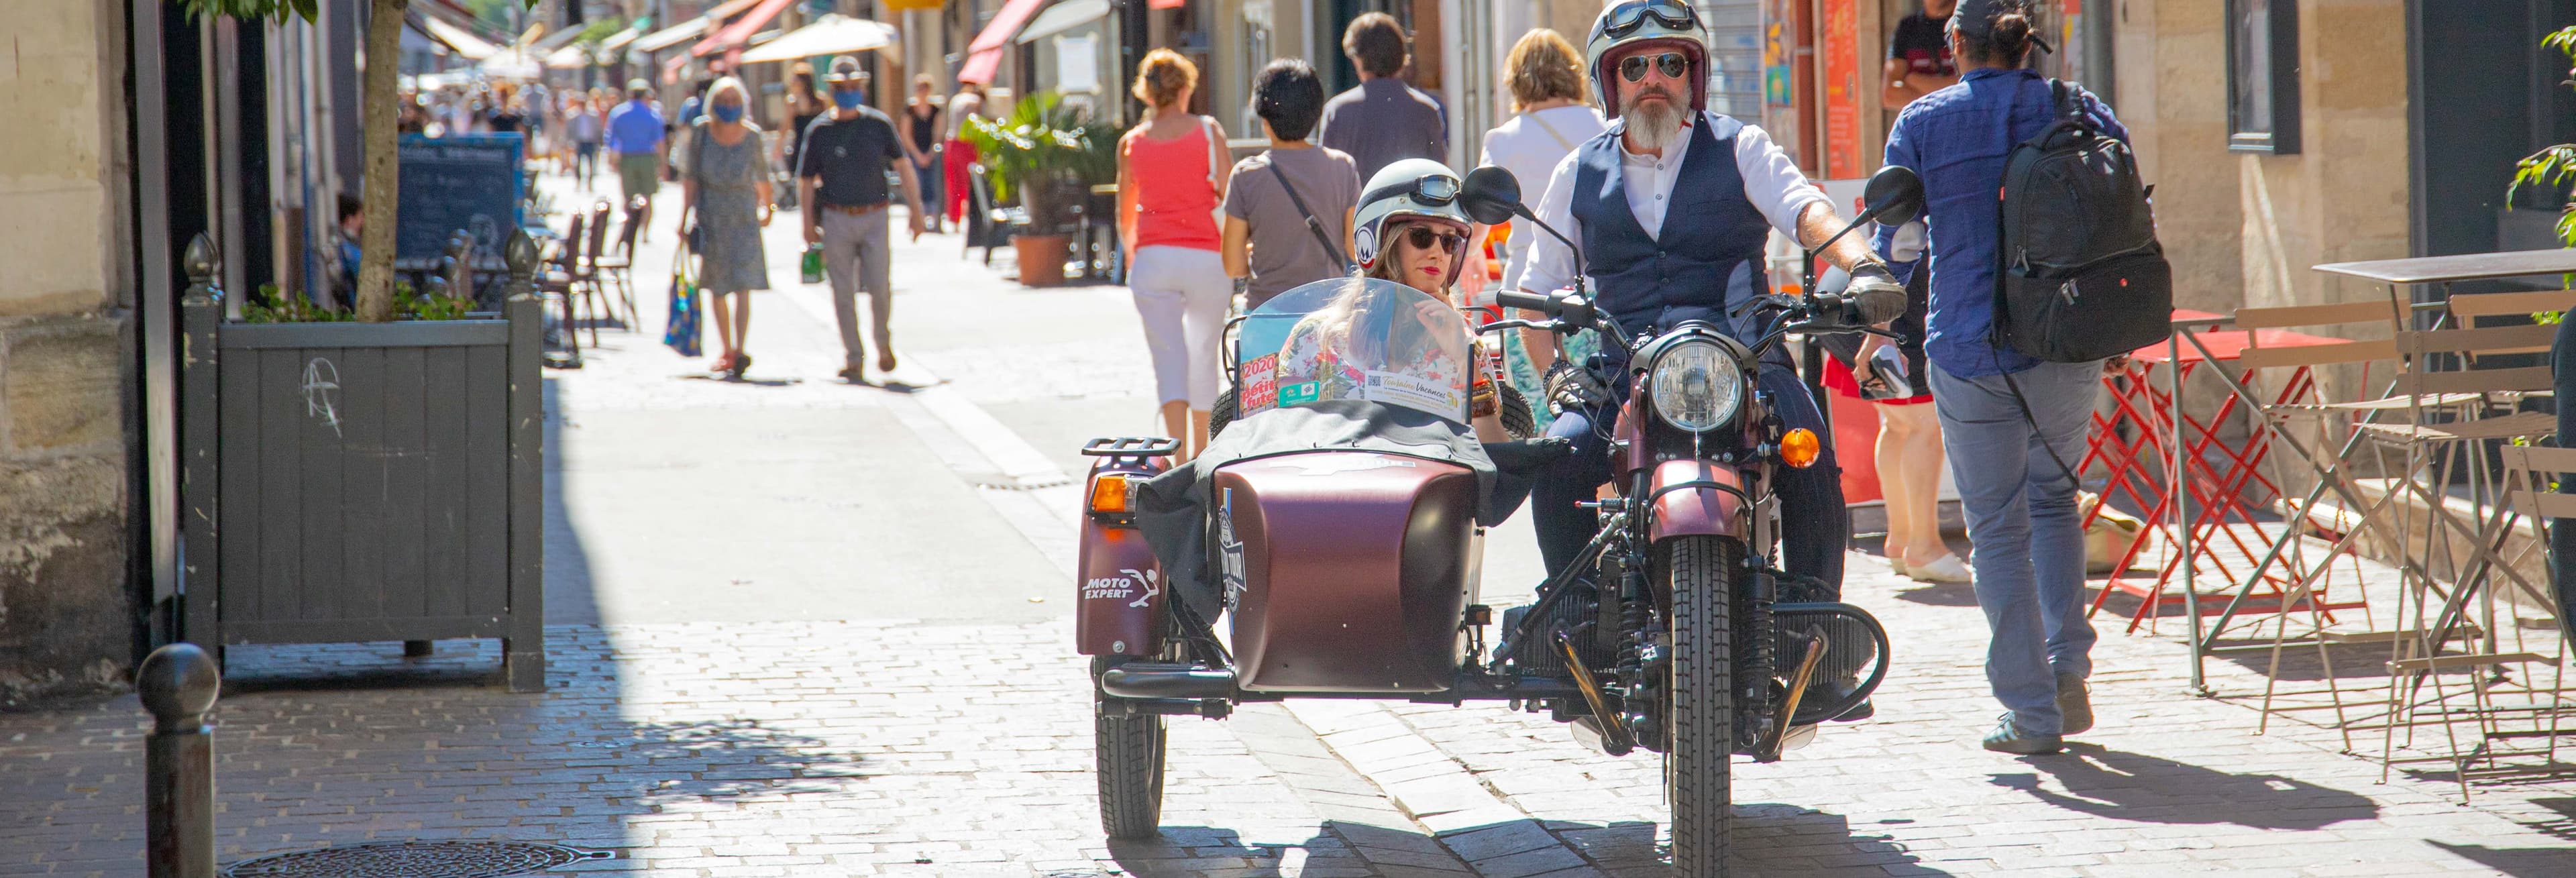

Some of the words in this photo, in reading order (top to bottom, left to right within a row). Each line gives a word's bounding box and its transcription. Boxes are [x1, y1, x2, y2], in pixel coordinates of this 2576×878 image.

[1244, 356, 1275, 379] 2020
[1242, 380, 1275, 402] petit
[1383, 376, 1415, 388] Touraine
[1415, 382, 1446, 399] Vacances
[1228, 552, 1243, 581] TOUR
[1082, 578, 1131, 590] MOTO
[1085, 589, 1133, 600] EXPERT
